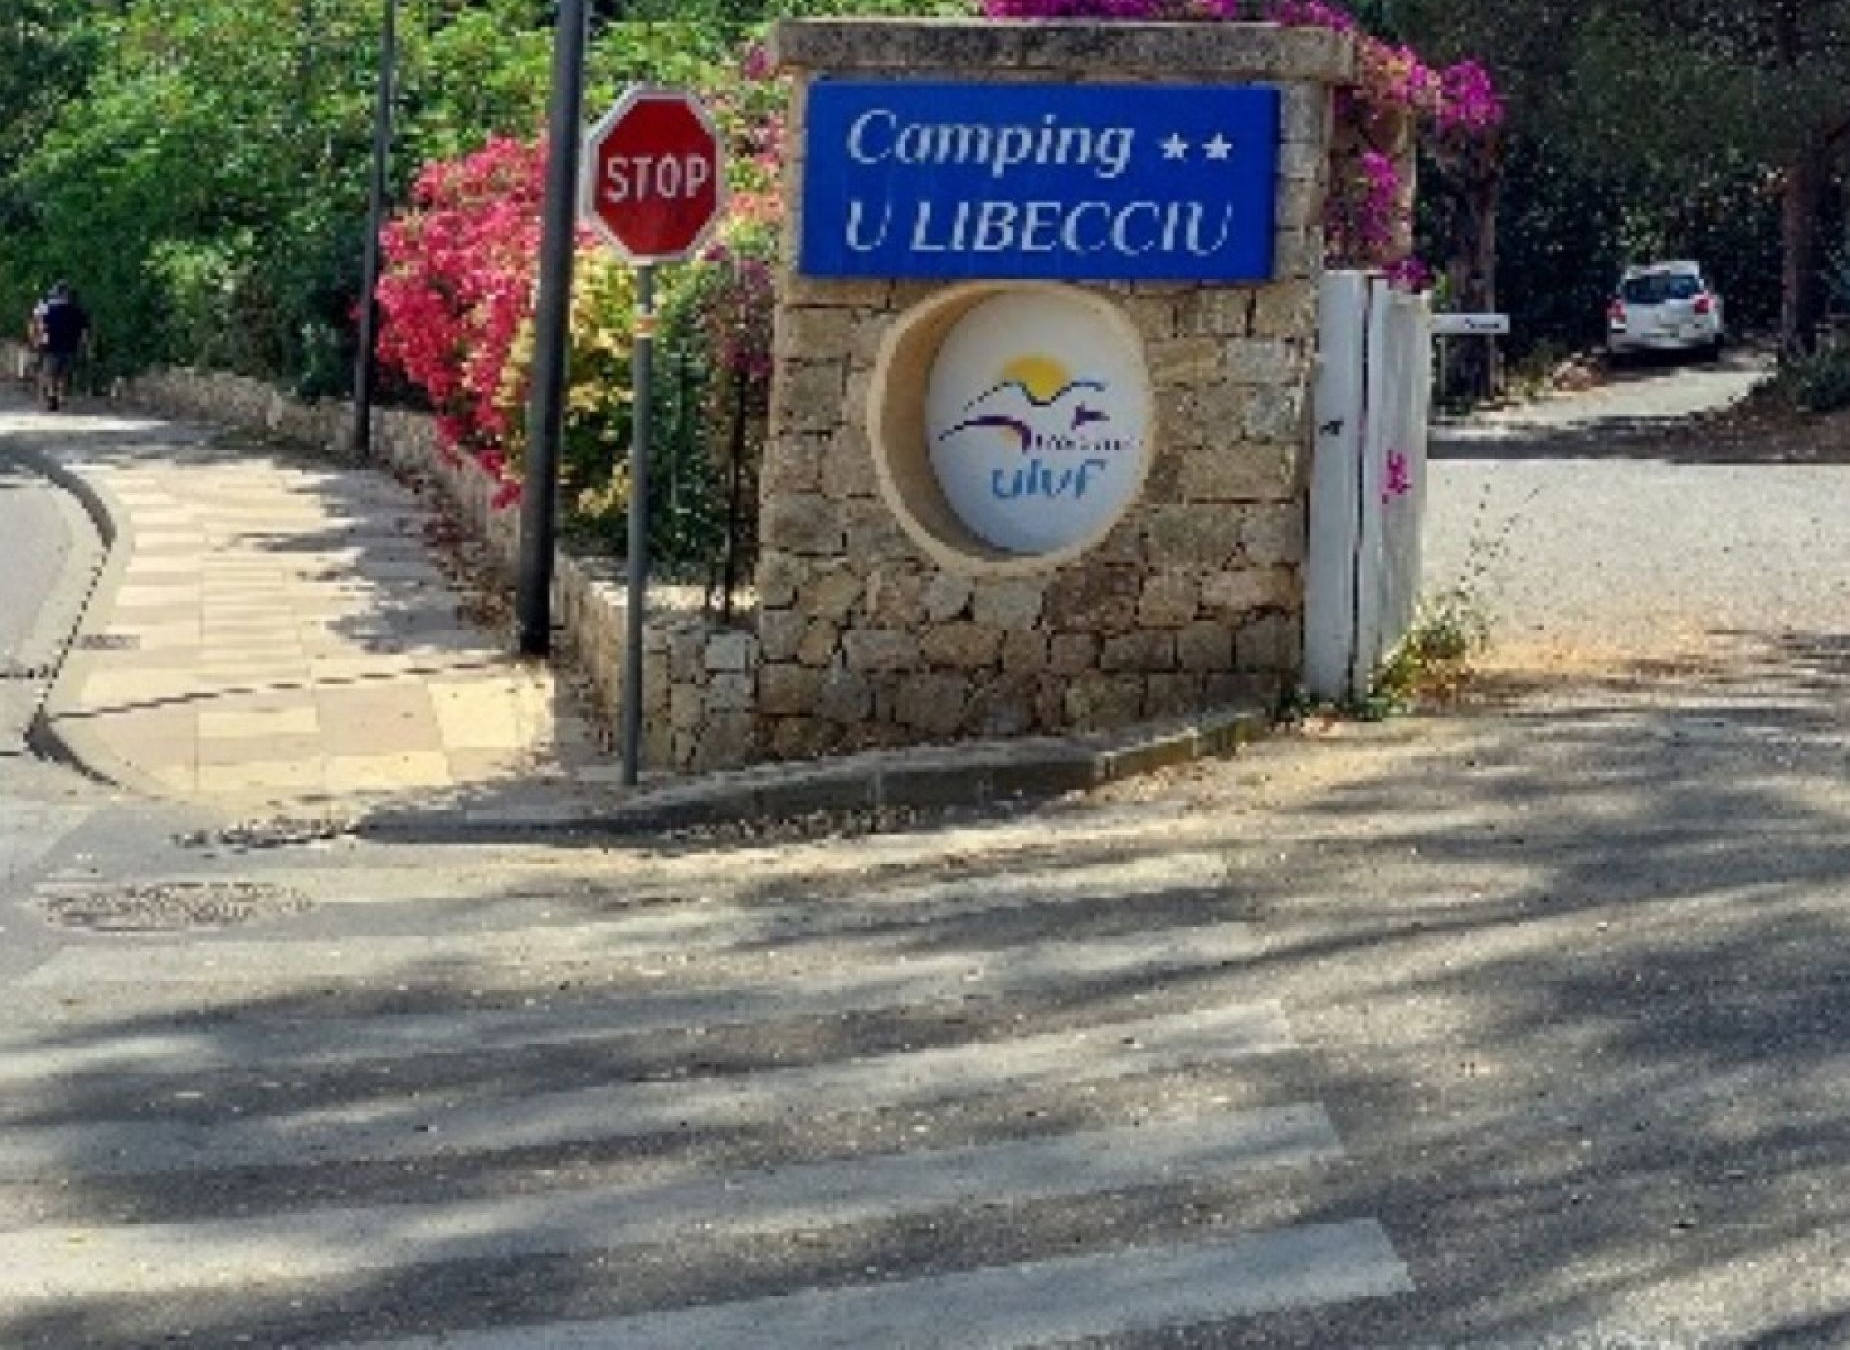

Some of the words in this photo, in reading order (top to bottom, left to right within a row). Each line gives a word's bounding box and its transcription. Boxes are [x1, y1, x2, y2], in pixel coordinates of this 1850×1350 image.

[846, 108, 1135, 178] Camping
[606, 153, 709, 203] STOP
[845, 200, 892, 252] U
[910, 200, 1234, 256] LIBECCIU
